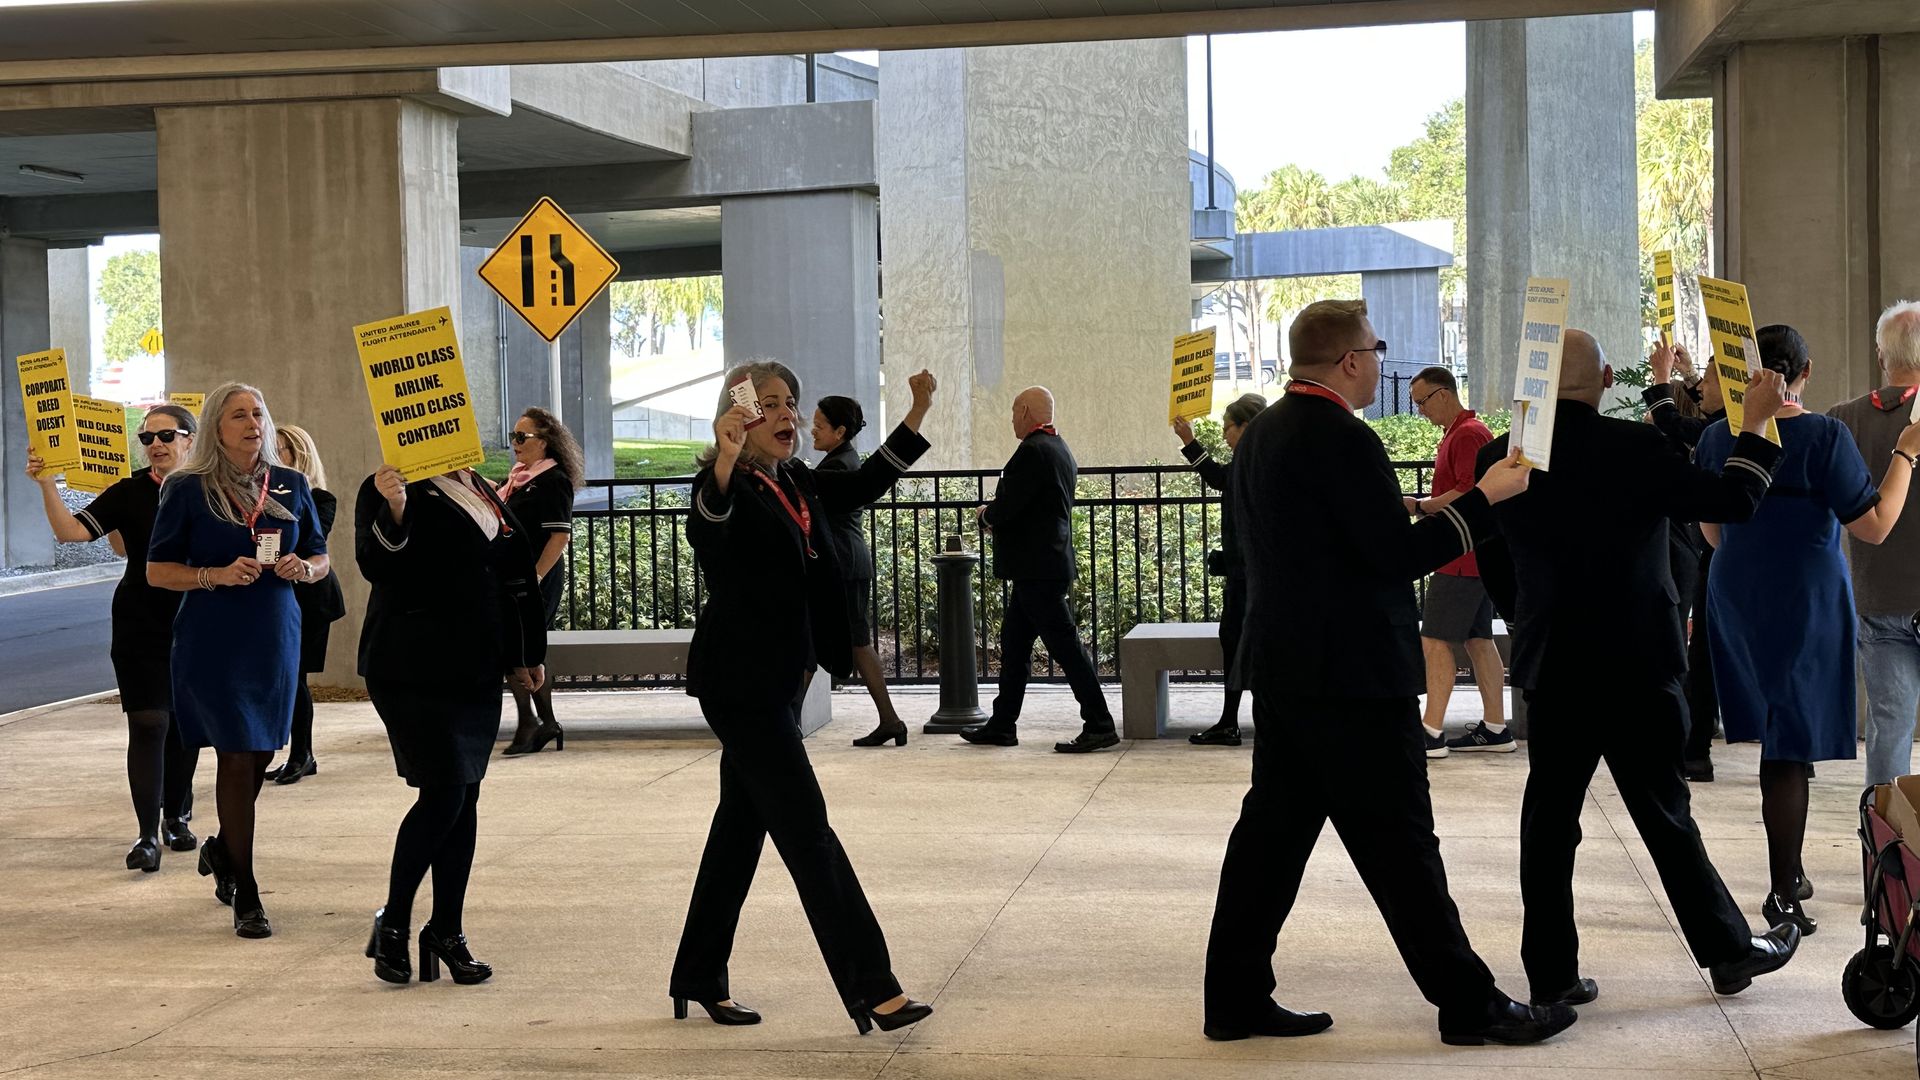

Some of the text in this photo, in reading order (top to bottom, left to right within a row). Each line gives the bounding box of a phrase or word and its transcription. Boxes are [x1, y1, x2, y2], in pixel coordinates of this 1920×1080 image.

[360, 320, 420, 338] UNITED AIRLINES
[362, 325, 436, 347] FLIGHT ATTENDANTS
[1525, 322, 1560, 344] CORPORATE
[1708, 316, 1751, 338] WORLD CLASS
[369, 346, 455, 378] WORLD CLASS
[1174, 348, 1214, 366] WORLD CLASS
[1529, 350, 1549, 371] GREED
[26, 378, 66, 397] CORPORATE
[394, 374, 444, 398] AIRLINE,
[1172, 374, 1212, 392] WORLD CLASS
[1176, 388, 1206, 404] CONTRACT
[36, 398, 60, 414] GREED
[380, 392, 466, 426] WORLD CLASS
[96, 422, 122, 434] CLASS
[396, 418, 461, 447] CONTRACT
[48, 434, 60, 448] FLY
[98, 450, 126, 462] CLASS
